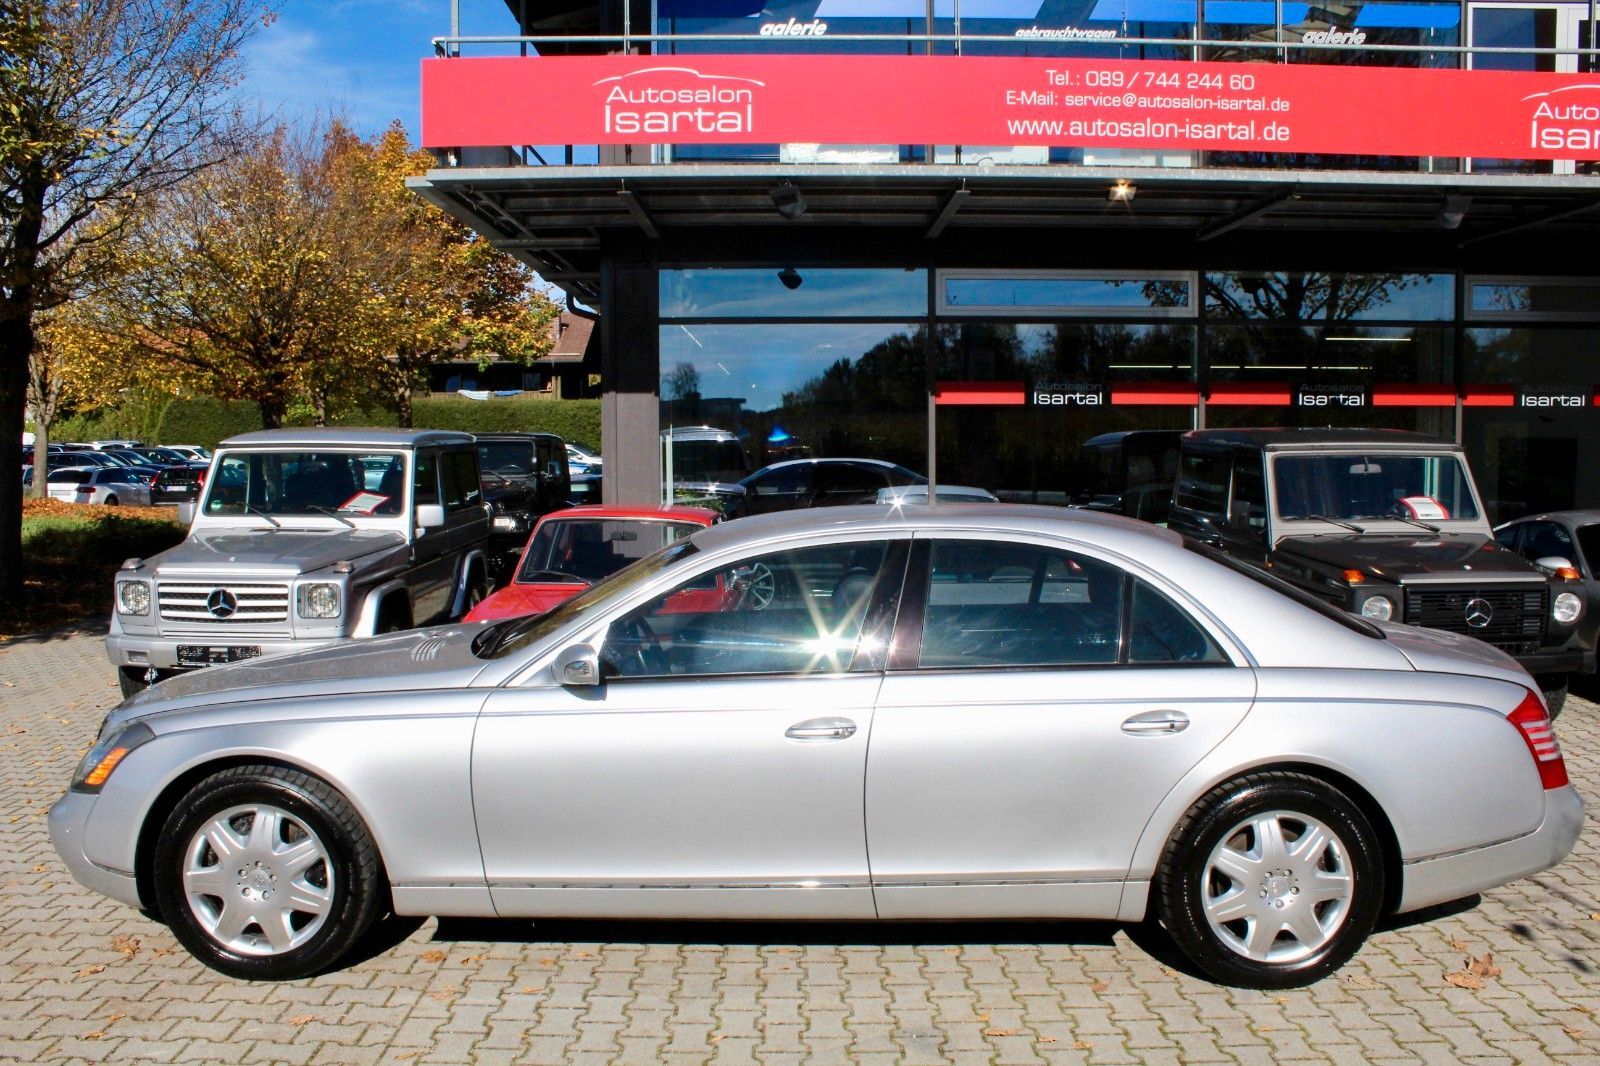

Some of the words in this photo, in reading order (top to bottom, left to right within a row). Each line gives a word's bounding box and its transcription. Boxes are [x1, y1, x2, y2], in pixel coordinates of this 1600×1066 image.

[1046, 69, 1081, 87] Tel.:
[1085, 70, 1125, 88] 089
[1128, 72, 1140, 89] /
[1143, 72, 1181, 89] 744
[1186, 73, 1224, 90] 244
[1229, 74, 1256, 91] 60
[606, 85, 752, 103] Autosalon
[1006, 90, 1059, 107] E-Mail:
[1065, 91, 1291, 112] service@autosalon-isartal.de
[604, 104, 753, 134] Isartal
[1532, 101, 1600, 121] Auto
[1007, 117, 1291, 142] www.autosalon-isartal.de
[1033, 391, 1103, 405] Isartal
[1521, 394, 1586, 406] Isartal
